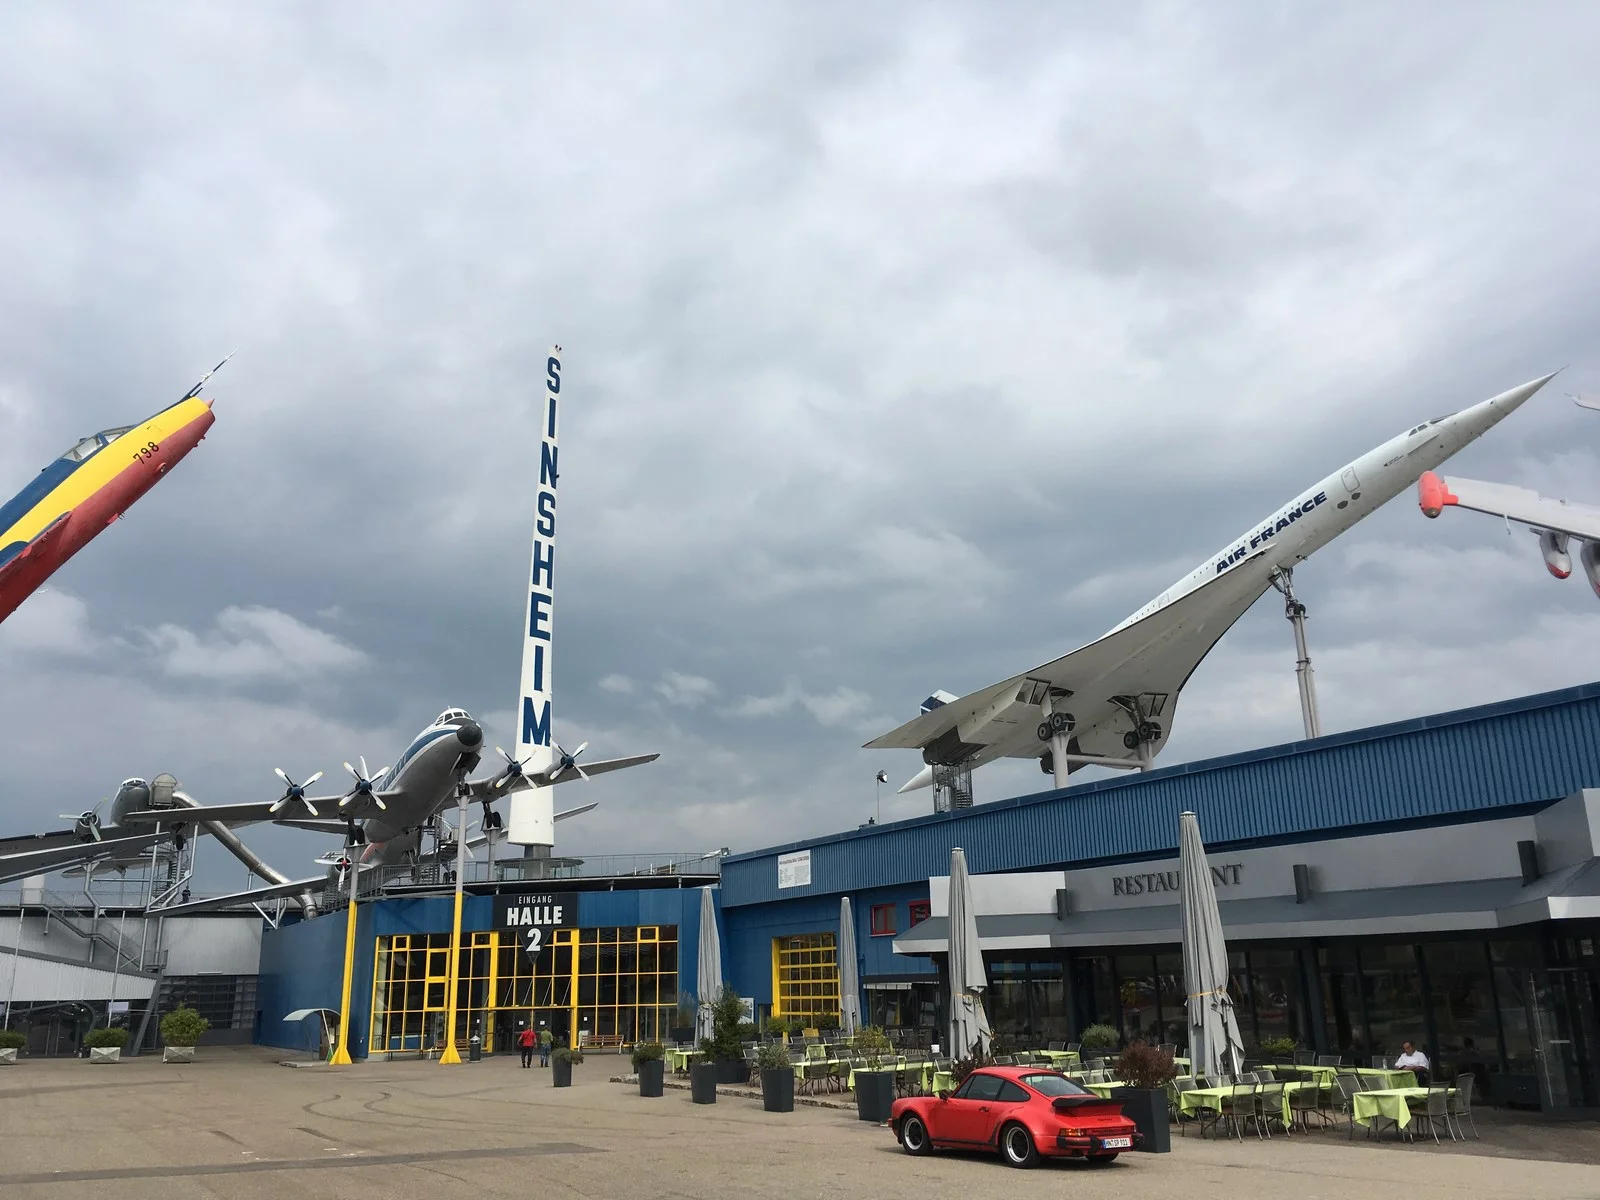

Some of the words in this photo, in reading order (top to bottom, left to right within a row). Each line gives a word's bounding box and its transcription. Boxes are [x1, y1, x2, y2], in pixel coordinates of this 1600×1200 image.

[133, 441, 159, 464] 798
[1216, 546, 1247, 574] AIR
[1250, 491, 1327, 549] FRANCE
[522, 356, 562, 748] SINSHEIM
[1112, 863, 1243, 896] RESTAUNT
[518, 895, 552, 904] EINGANG
[507, 906, 562, 926] HALLE
[526, 928, 542, 951] 2
